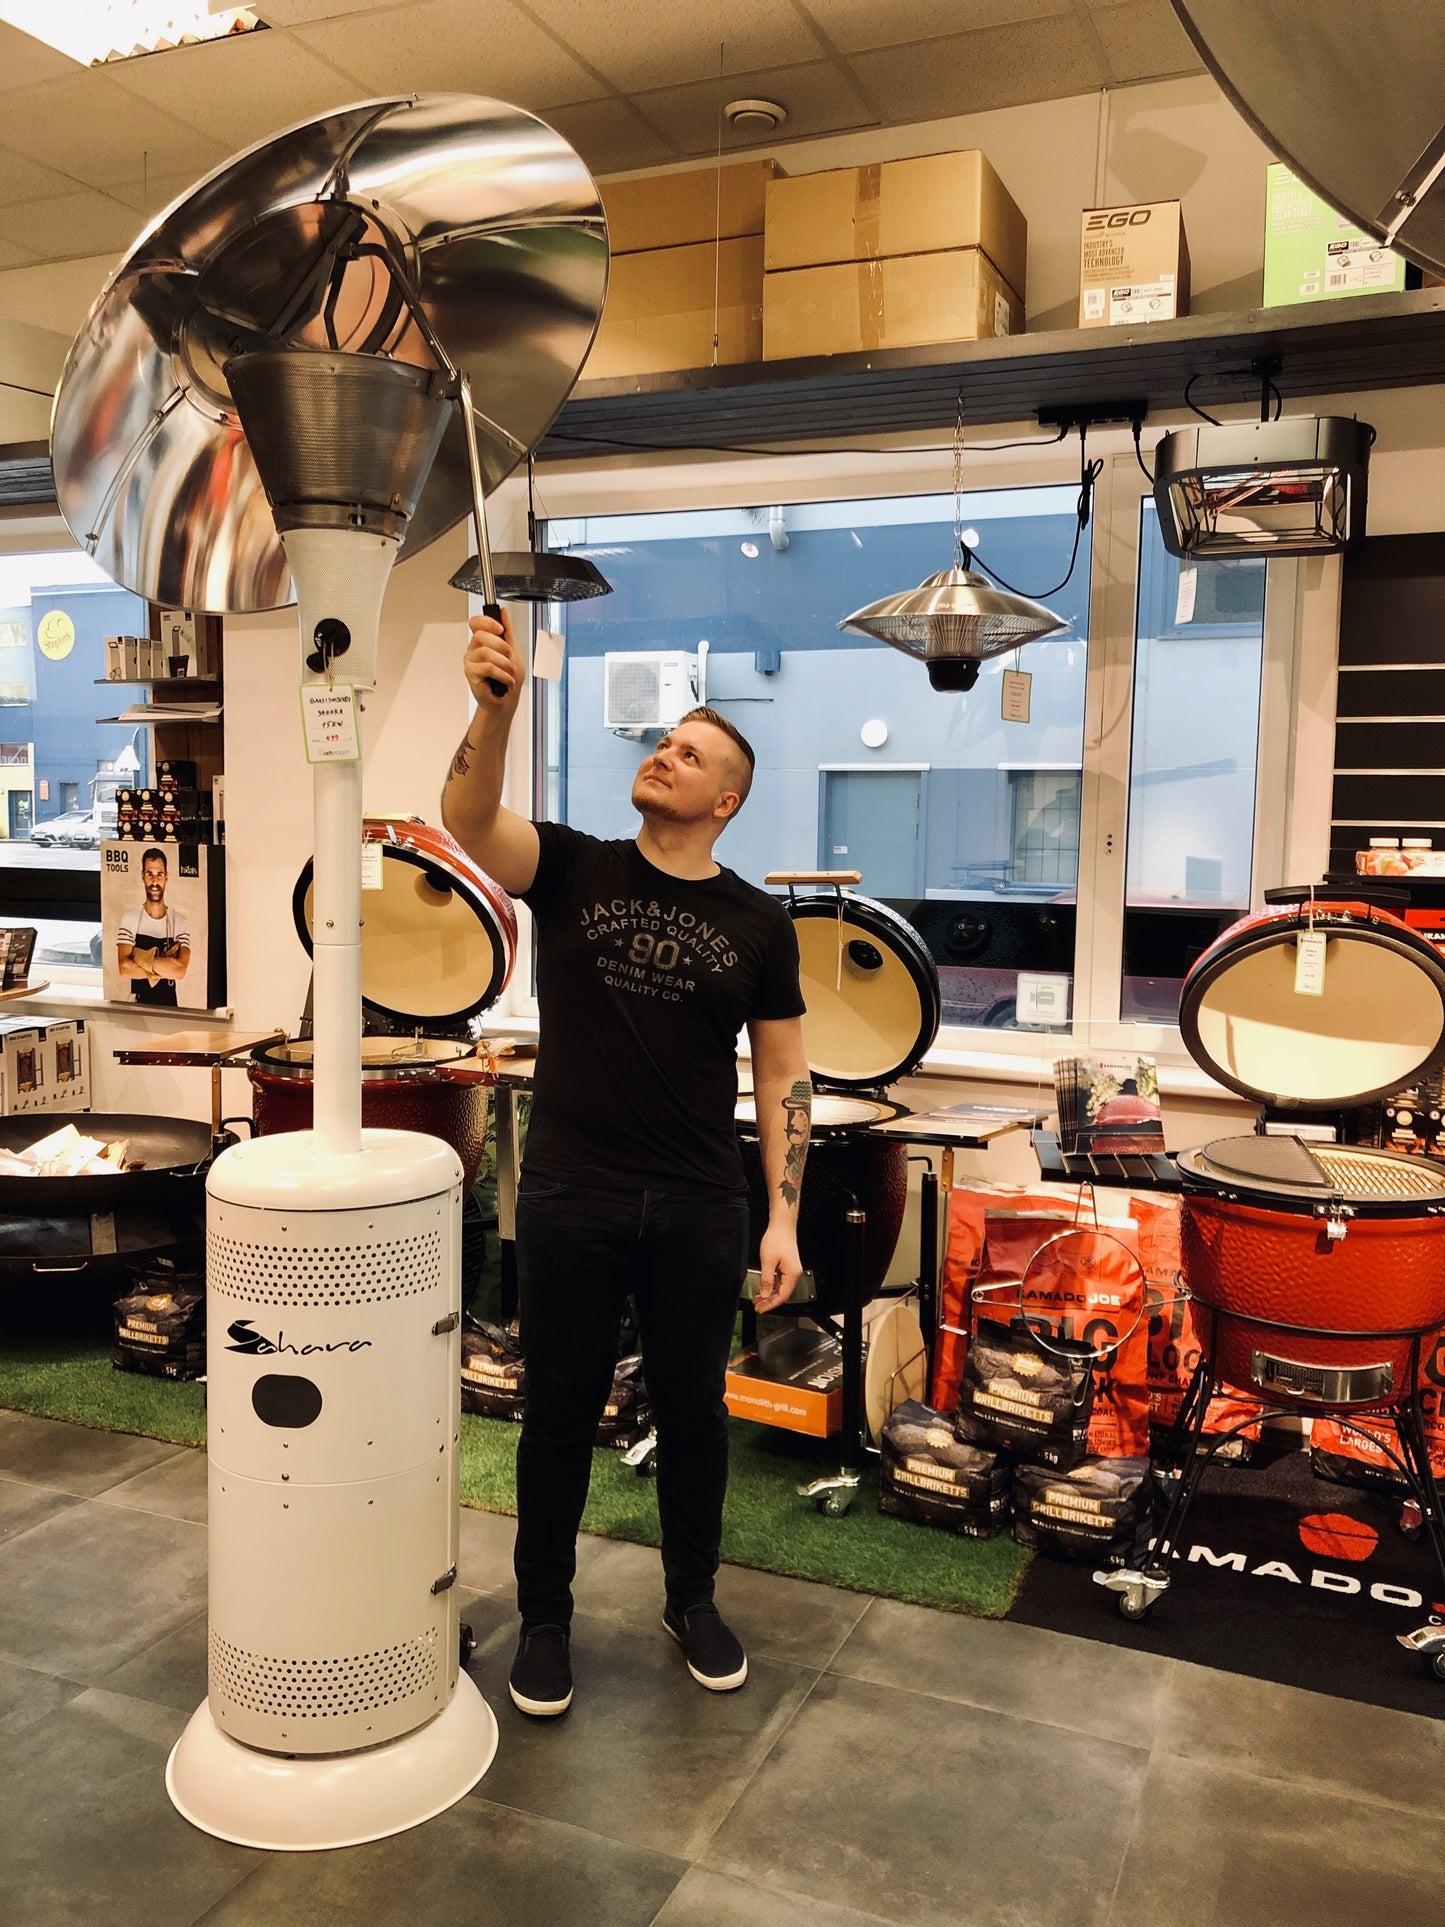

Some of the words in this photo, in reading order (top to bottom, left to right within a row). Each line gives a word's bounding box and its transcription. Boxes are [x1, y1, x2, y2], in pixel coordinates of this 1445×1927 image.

[1086, 209, 1152, 231] EGO
[1084, 256, 1124, 268] TECHNOLOGY
[106, 850, 129, 863] BBQ
[106, 864, 129, 872] TOOLS
[586, 918, 661, 941] CRAFTED
[666, 926, 724, 974] QUALITY
[628, 933, 680, 970] 90
[596, 956, 646, 980] DENIM
[651, 972, 697, 992] WEAR
[604, 975, 659, 998] QUALITY
[1088, 1293, 1121, 1306] JOE
[127, 1320, 157, 1333] PREMIUM
[224, 1319, 372, 1355] Sahara
[990, 1384, 1039, 1405] PREMIUM
[974, 1392, 1053, 1422] GRILLBRIKETTS
[1340, 1434, 1386, 1454] LARGES
[1049, 1452, 1058, 1464] kg
[908, 1461, 955, 1480] PREMIUM
[894, 1469, 968, 1497] GRILLBRIKETTS
[1048, 1491, 1099, 1512] PREMIUM
[1032, 1501, 1114, 1527] GRILLBRIKETTS
[1149, 1537, 1422, 1608] AMADO
